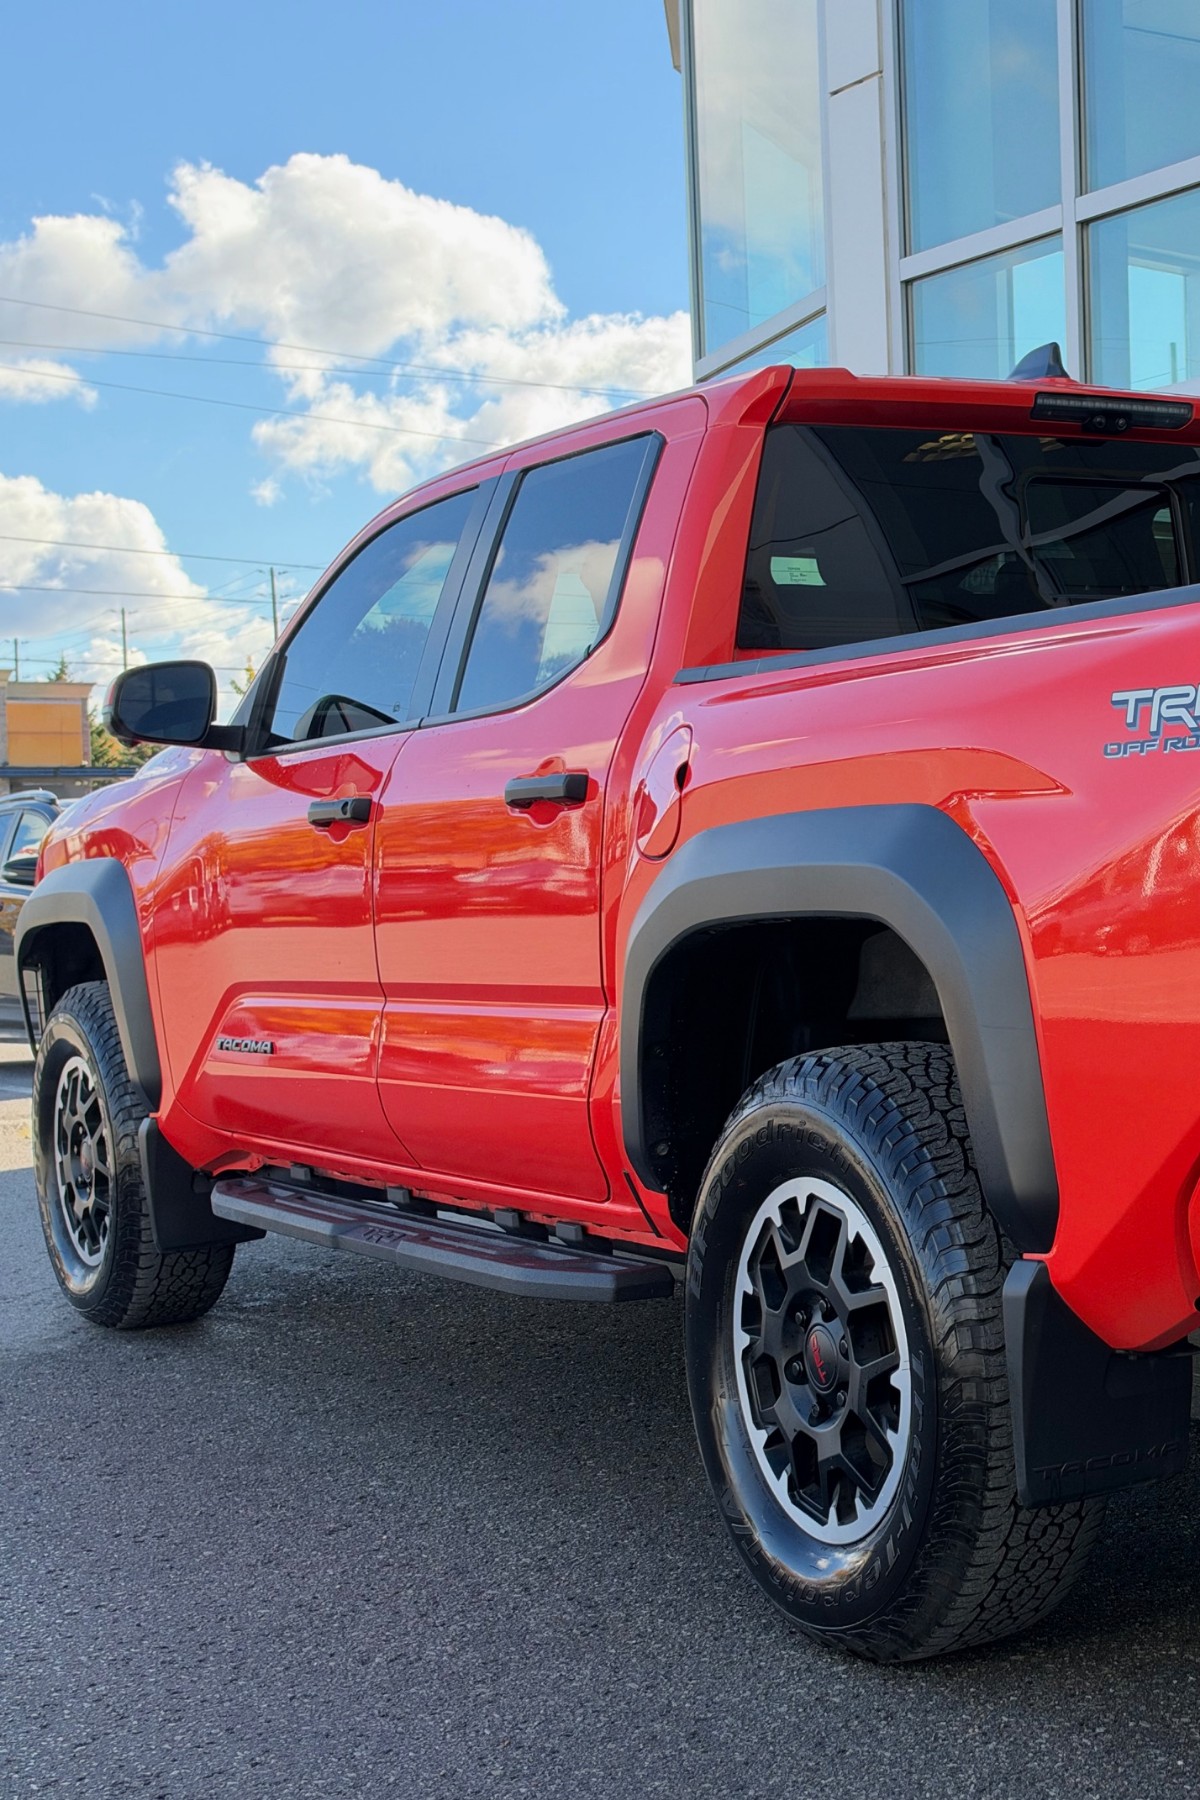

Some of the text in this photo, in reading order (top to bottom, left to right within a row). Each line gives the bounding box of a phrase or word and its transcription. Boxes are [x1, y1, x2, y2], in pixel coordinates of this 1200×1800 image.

[1103, 739, 1159, 759] OFF
[216, 1038, 274, 1055] TACOMA
[687, 1119, 851, 1299] BFGoodrich
